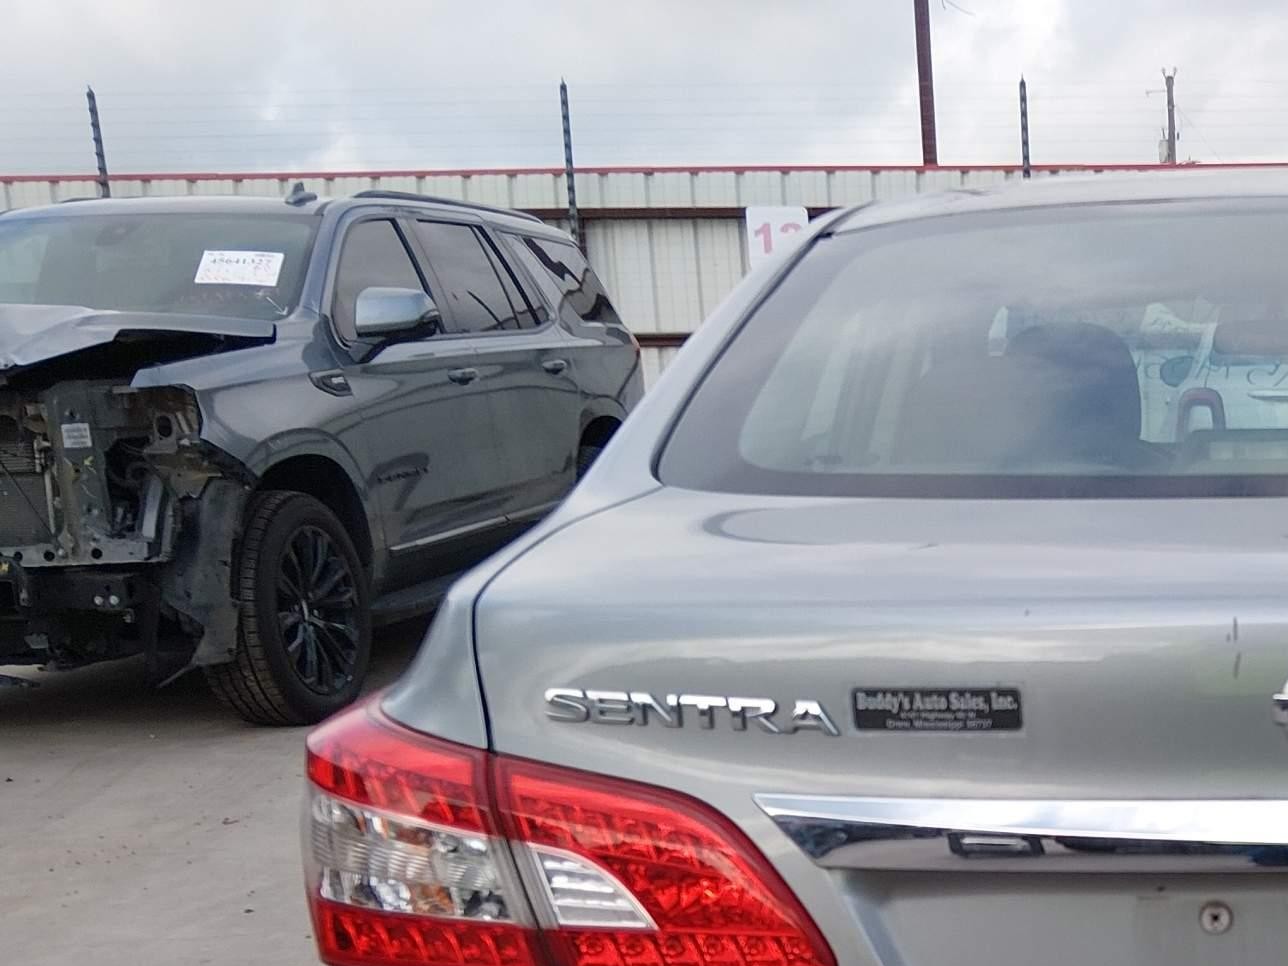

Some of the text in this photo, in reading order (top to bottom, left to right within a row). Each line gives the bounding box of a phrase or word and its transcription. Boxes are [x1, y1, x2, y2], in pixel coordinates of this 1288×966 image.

[544, 688, 841, 736] SENTRA
[856, 691, 911, 714] Buddy's
[912, 692, 948, 710] Auto
[990, 691, 1018, 711] Inc.
